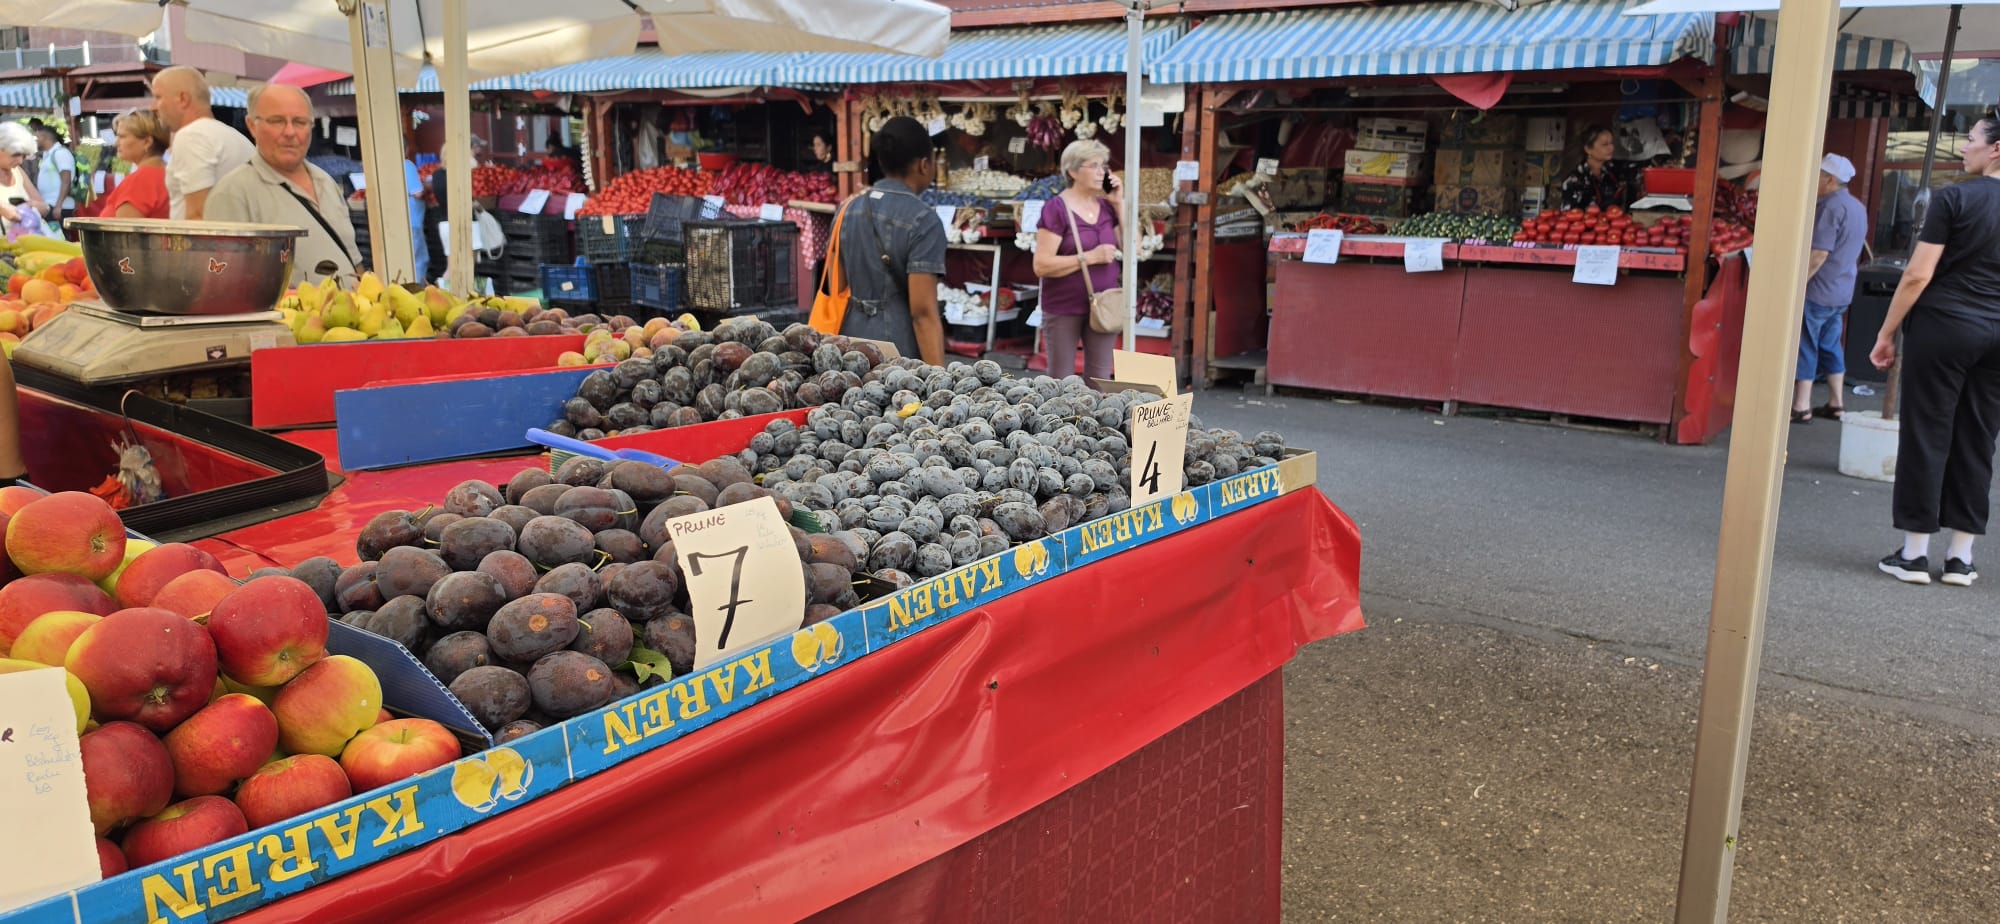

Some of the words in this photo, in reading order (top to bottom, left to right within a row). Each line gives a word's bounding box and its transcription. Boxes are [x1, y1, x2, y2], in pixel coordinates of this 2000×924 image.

[1137, 403, 1173, 423] PRUNE
[1139, 440, 1162, 494] 4
[1221, 468, 1281, 507] KAREN
[672, 513, 726, 536] PRUNE
[1081, 503, 1164, 554] KAREN
[687, 545, 754, 650] 7
[888, 557, 1003, 632] KAREN
[603, 648, 775, 755] KAREN
[140, 785, 425, 924] KAREN
